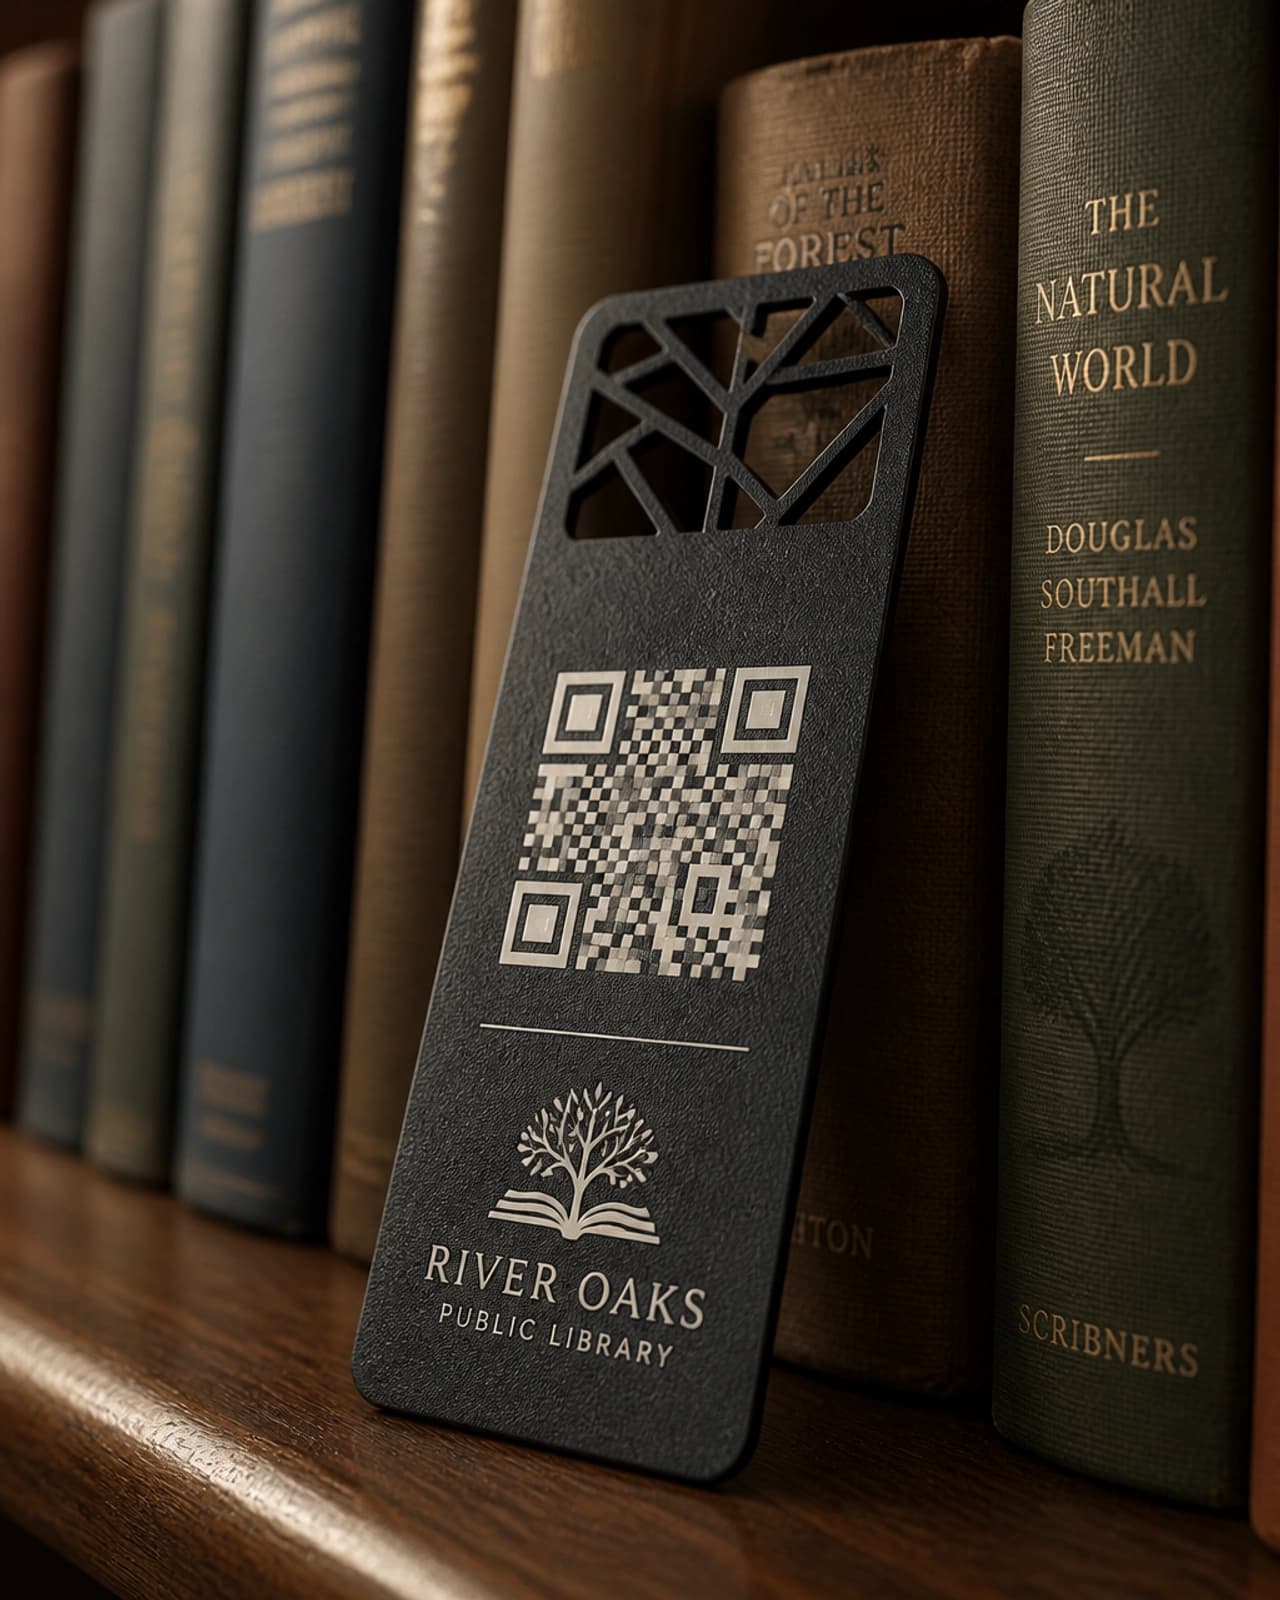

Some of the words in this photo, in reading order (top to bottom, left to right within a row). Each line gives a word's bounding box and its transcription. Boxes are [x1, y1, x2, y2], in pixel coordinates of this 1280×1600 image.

[768, 192, 808, 229] OF
[822, 180, 884, 220] THE
[1084, 188, 1161, 236] THE
[755, 223, 906, 273] FOREST
[1034, 256, 1230, 325] NATURAL
[1050, 338, 1198, 397] WORLD
[1045, 516, 1198, 554] DOUGLAS
[1040, 573, 1208, 609] SOUTHALL
[1043, 629, 1196, 664] FREEMAN
[424, 1244, 558, 1304] RIVER
[578, 1271, 706, 1330] OAKS
[438, 1302, 537, 1341] PUBLIC
[549, 1323, 674, 1368] LIBRARY
[1018, 1303, 1199, 1378] SCRIBNERS
